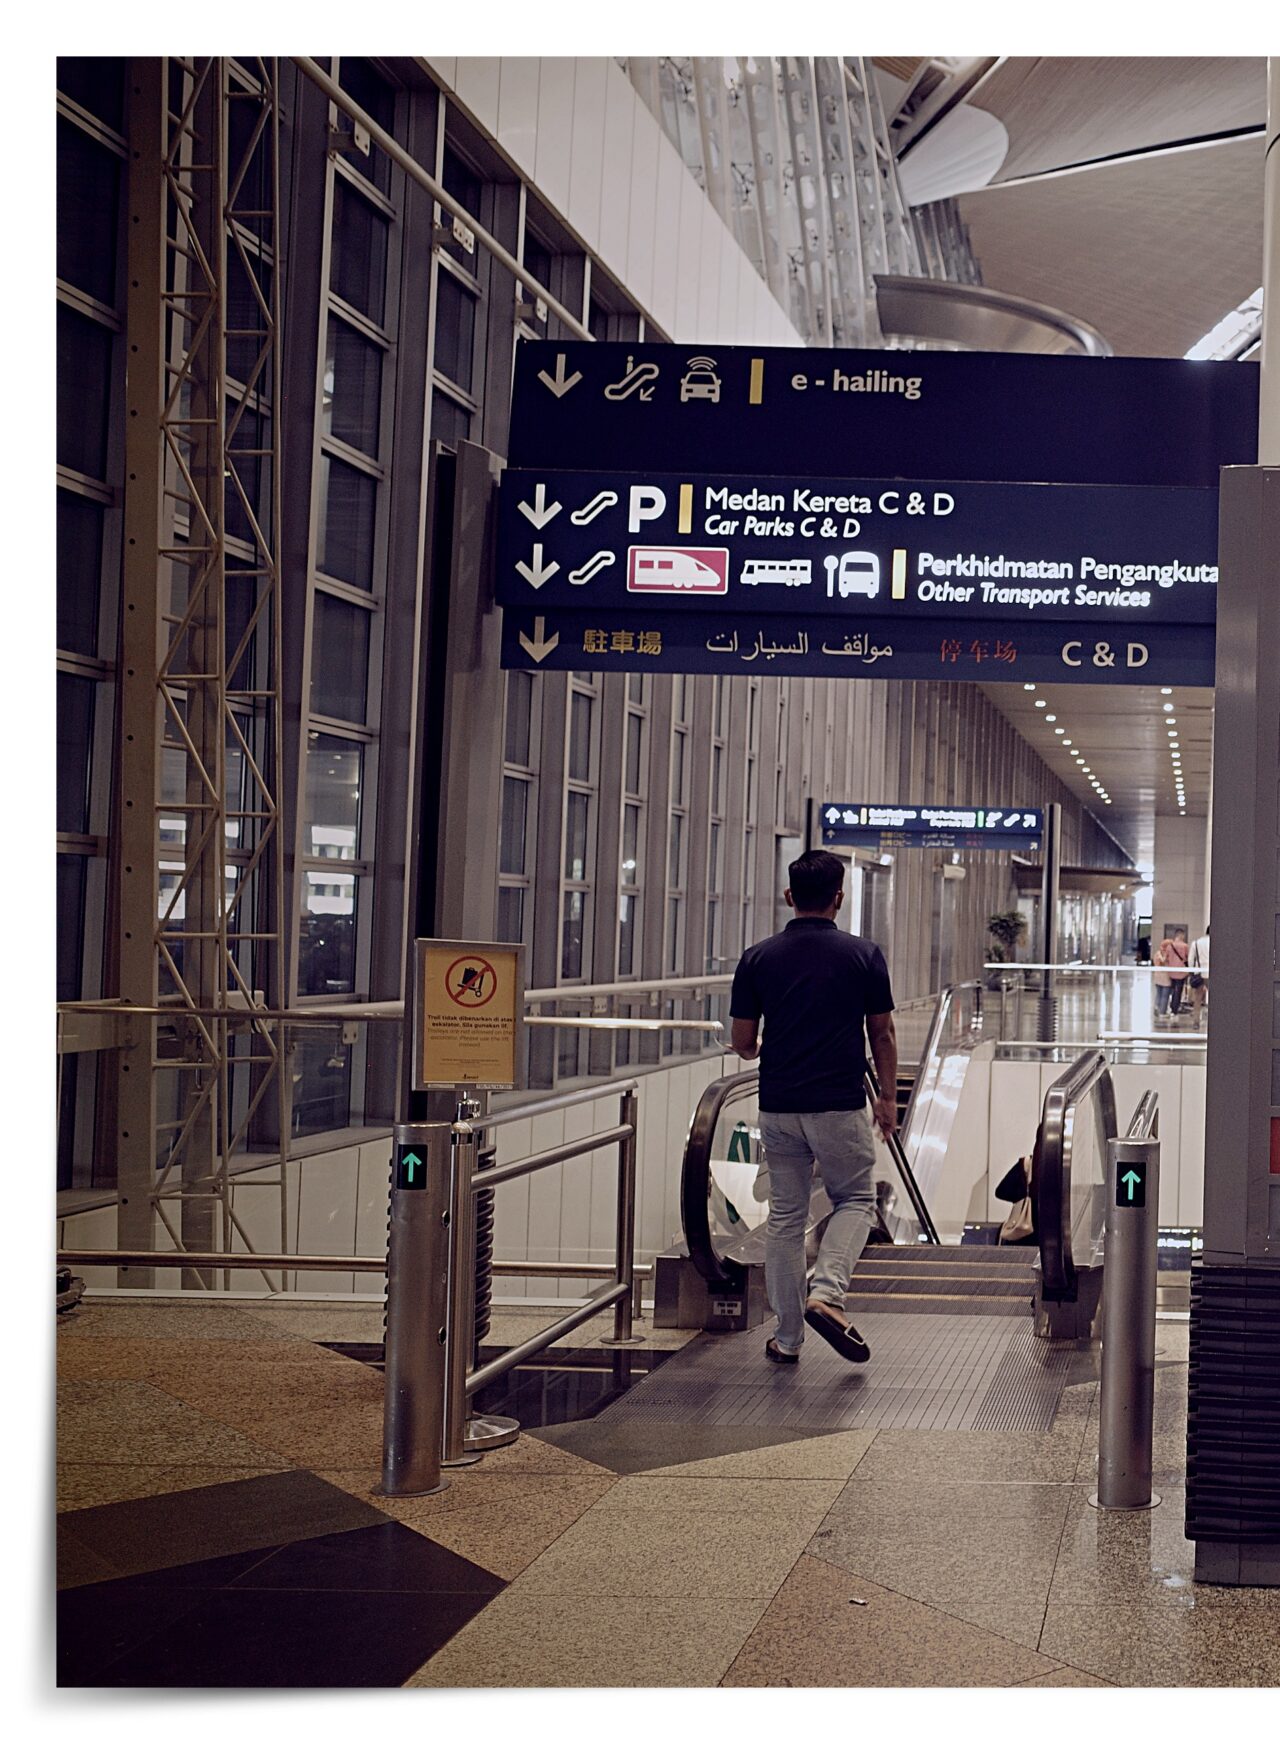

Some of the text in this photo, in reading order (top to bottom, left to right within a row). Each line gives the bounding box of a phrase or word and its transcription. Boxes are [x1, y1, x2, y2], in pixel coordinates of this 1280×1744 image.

[791, 373, 808, 390] e
[833, 369, 922, 400] hailing
[705, 487, 955, 516] Medan Kereta C & D
[704, 515, 861, 538] Car Parks C & D
[917, 552, 1218, 587] Perkhidmatan Pengangkuta
[917, 580, 1151, 609] Other Transport Services
[583, 629, 662, 655] 駐車場
[706, 630, 893, 663] مواقف السيارات
[940, 639, 1018, 664] 停车场
[1061, 641, 1149, 668] C & D
